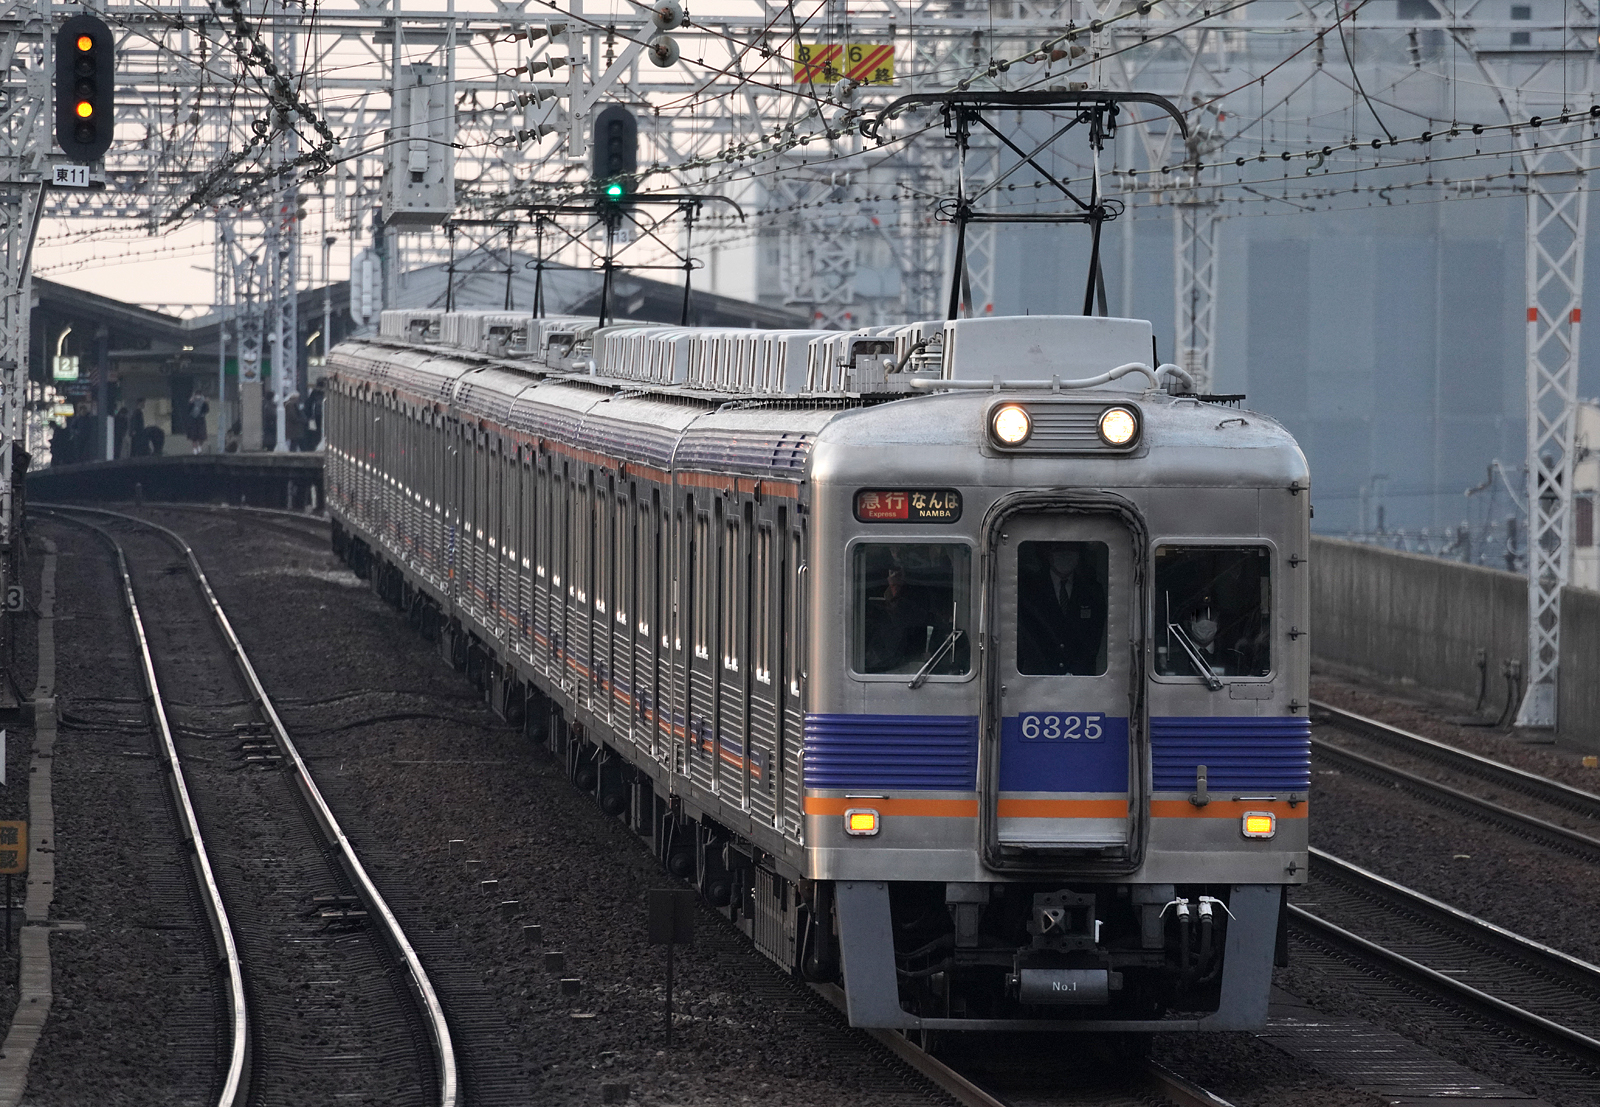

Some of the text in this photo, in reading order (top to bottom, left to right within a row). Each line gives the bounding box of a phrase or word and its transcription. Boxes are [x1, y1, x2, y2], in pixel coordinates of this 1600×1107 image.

[797, 46, 811, 62] 8
[849, 46, 862, 62] 6
[56, 168, 85, 183] 東11
[61, 358, 71, 370] 2
[861, 492, 905, 509] 急行
[1022, 715, 1103, 740] 6325
[1052, 981, 1077, 991] No.1
